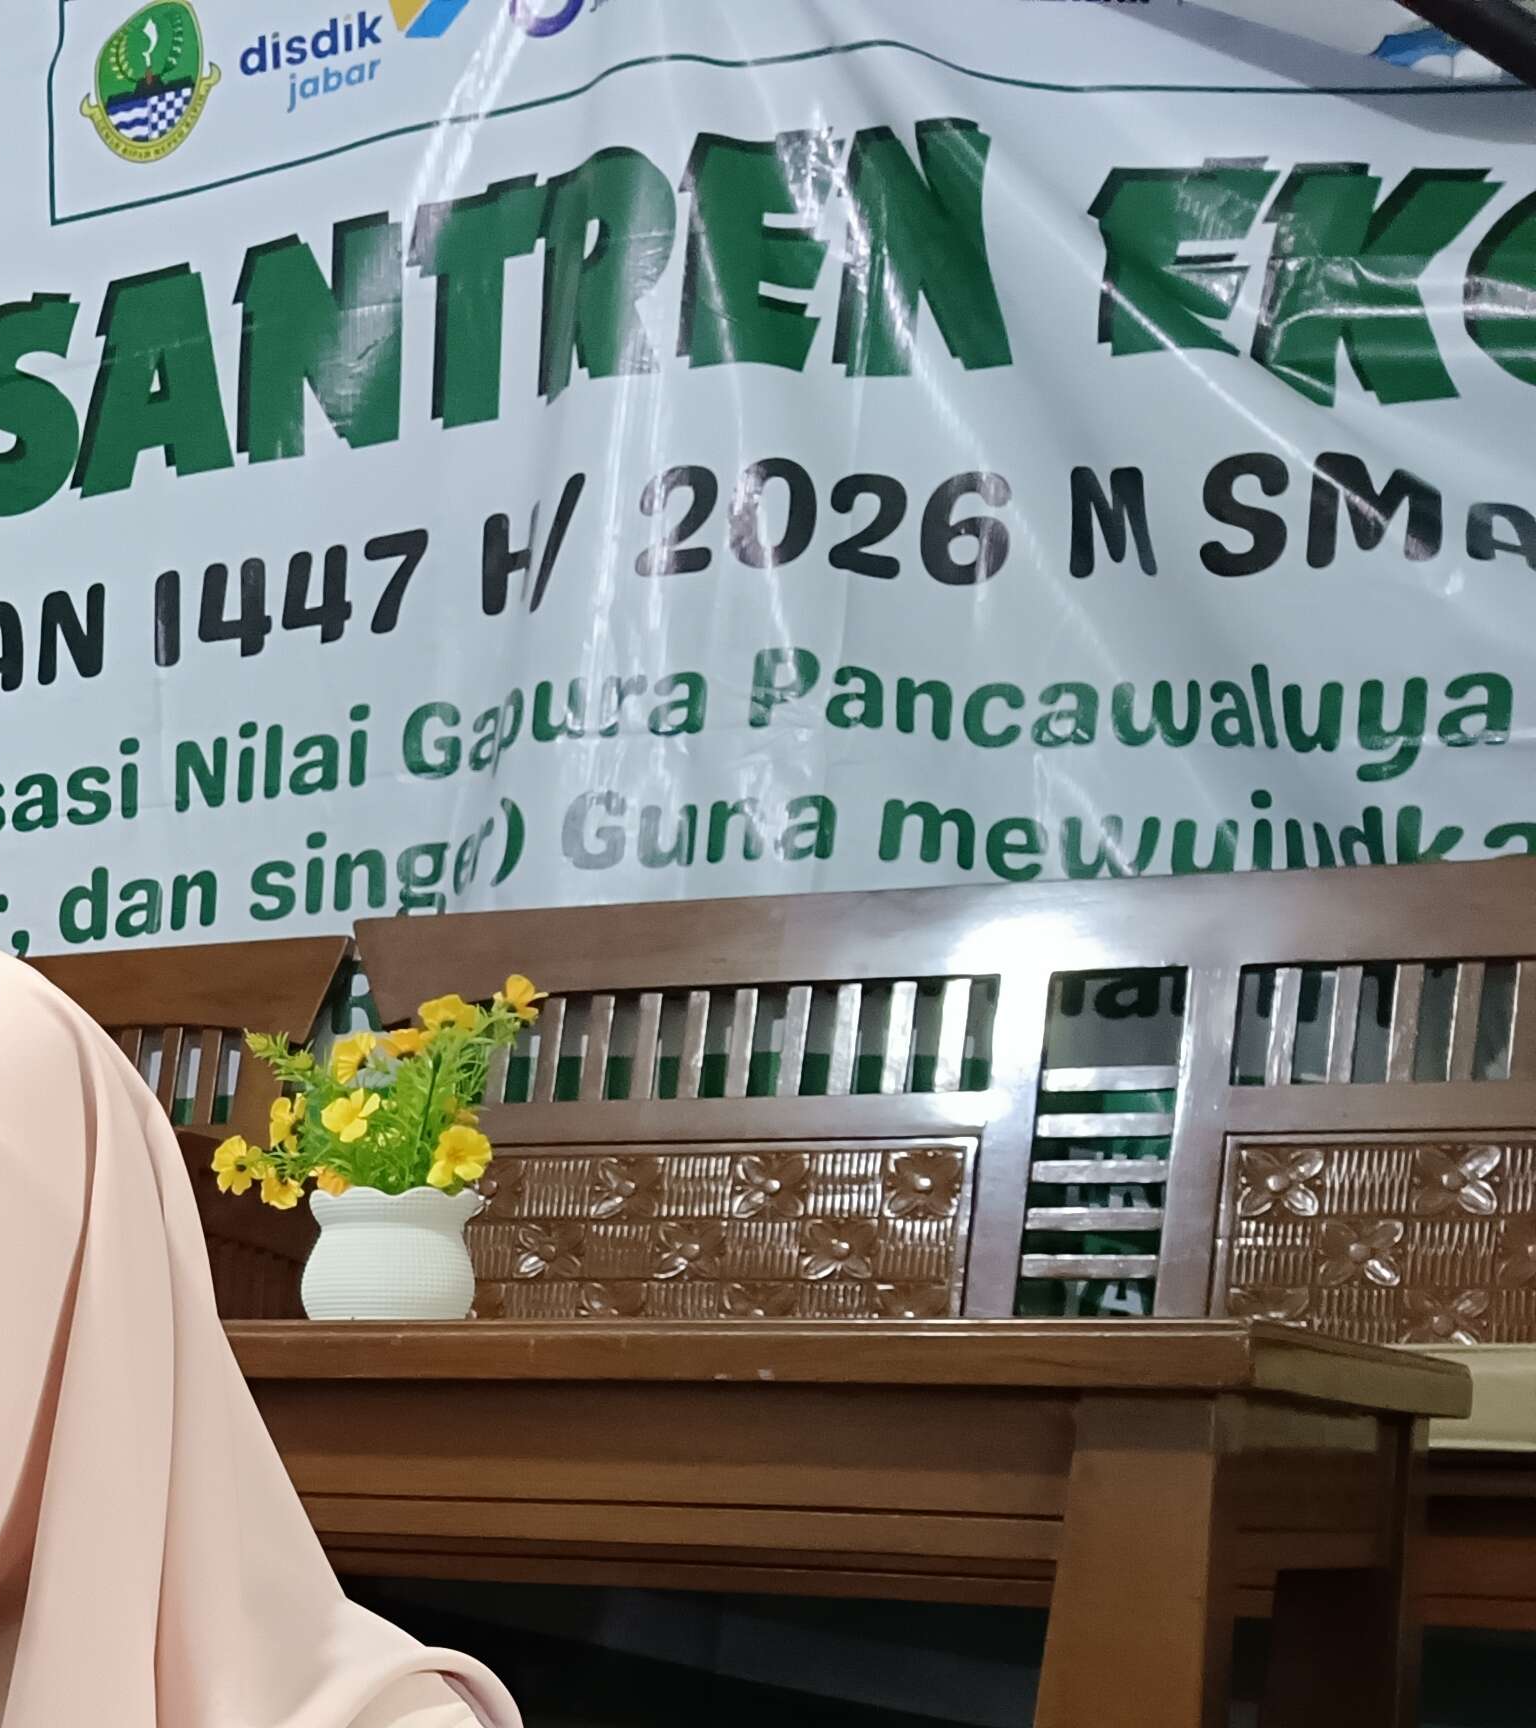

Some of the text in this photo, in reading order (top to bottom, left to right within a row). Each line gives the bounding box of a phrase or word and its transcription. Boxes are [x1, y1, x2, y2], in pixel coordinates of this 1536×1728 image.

[239, 10, 383, 76] disdik
[287, 58, 382, 113] jabar
[154, 527, 429, 667] 1447
[634, 456, 1012, 586] 2026
[1069, 466, 1158, 578] M
[174, 703, 371, 813] Nilai
[402, 670, 708, 780] Gapura
[748, 647, 1514, 782] Pancawaluya
[59, 866, 218, 944] dan
[561, 789, 837, 870] Guna
